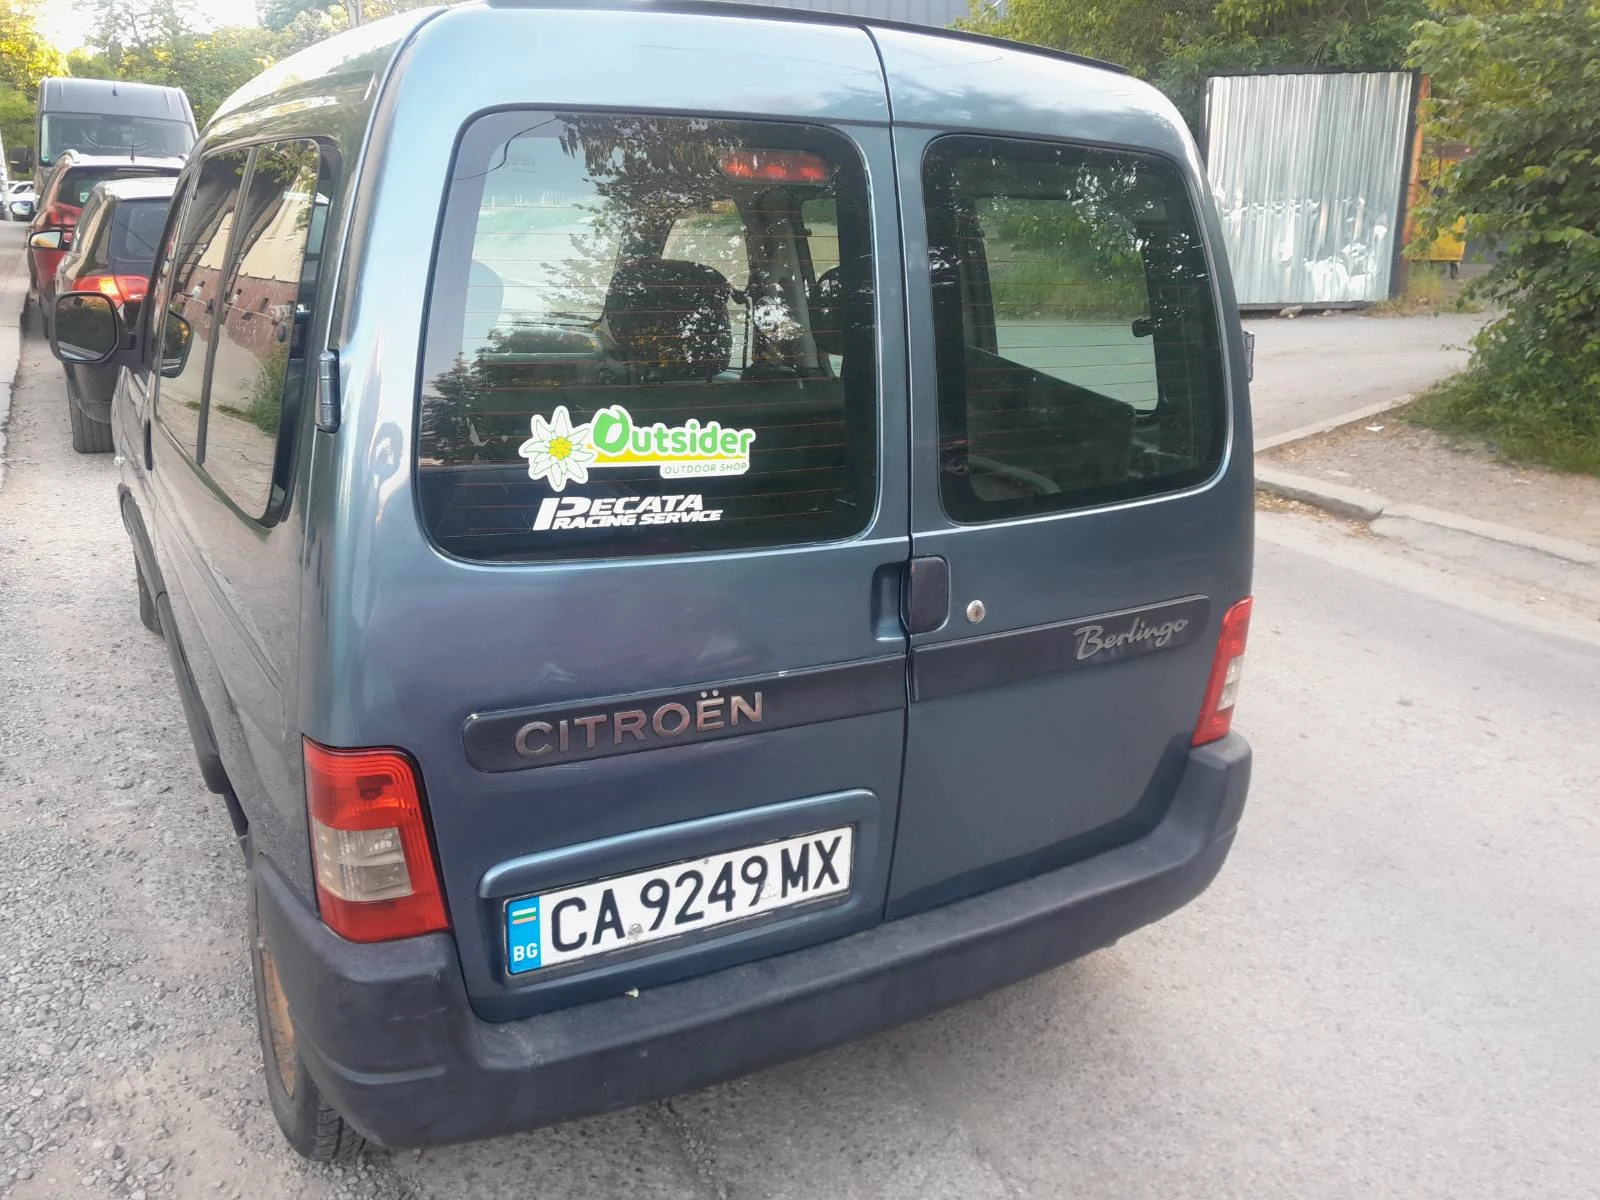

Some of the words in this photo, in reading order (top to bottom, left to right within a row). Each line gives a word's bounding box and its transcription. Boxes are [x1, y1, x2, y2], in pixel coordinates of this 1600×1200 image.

[593, 408, 753, 454] Outsider
[664, 463, 717, 475] OUTDOOR
[720, 462, 747, 473] SHOP
[532, 494, 704, 531] PECATA
[551, 511, 638, 530] RACING
[639, 509, 723, 525] SERVICE
[1073, 617, 1189, 661] Berlingo
[514, 689, 763, 759] CITROËN
[551, 888, 626, 952] CA
[639, 855, 769, 932] 9249
[780, 835, 843, 899] MX
[512, 942, 538, 962] BG
